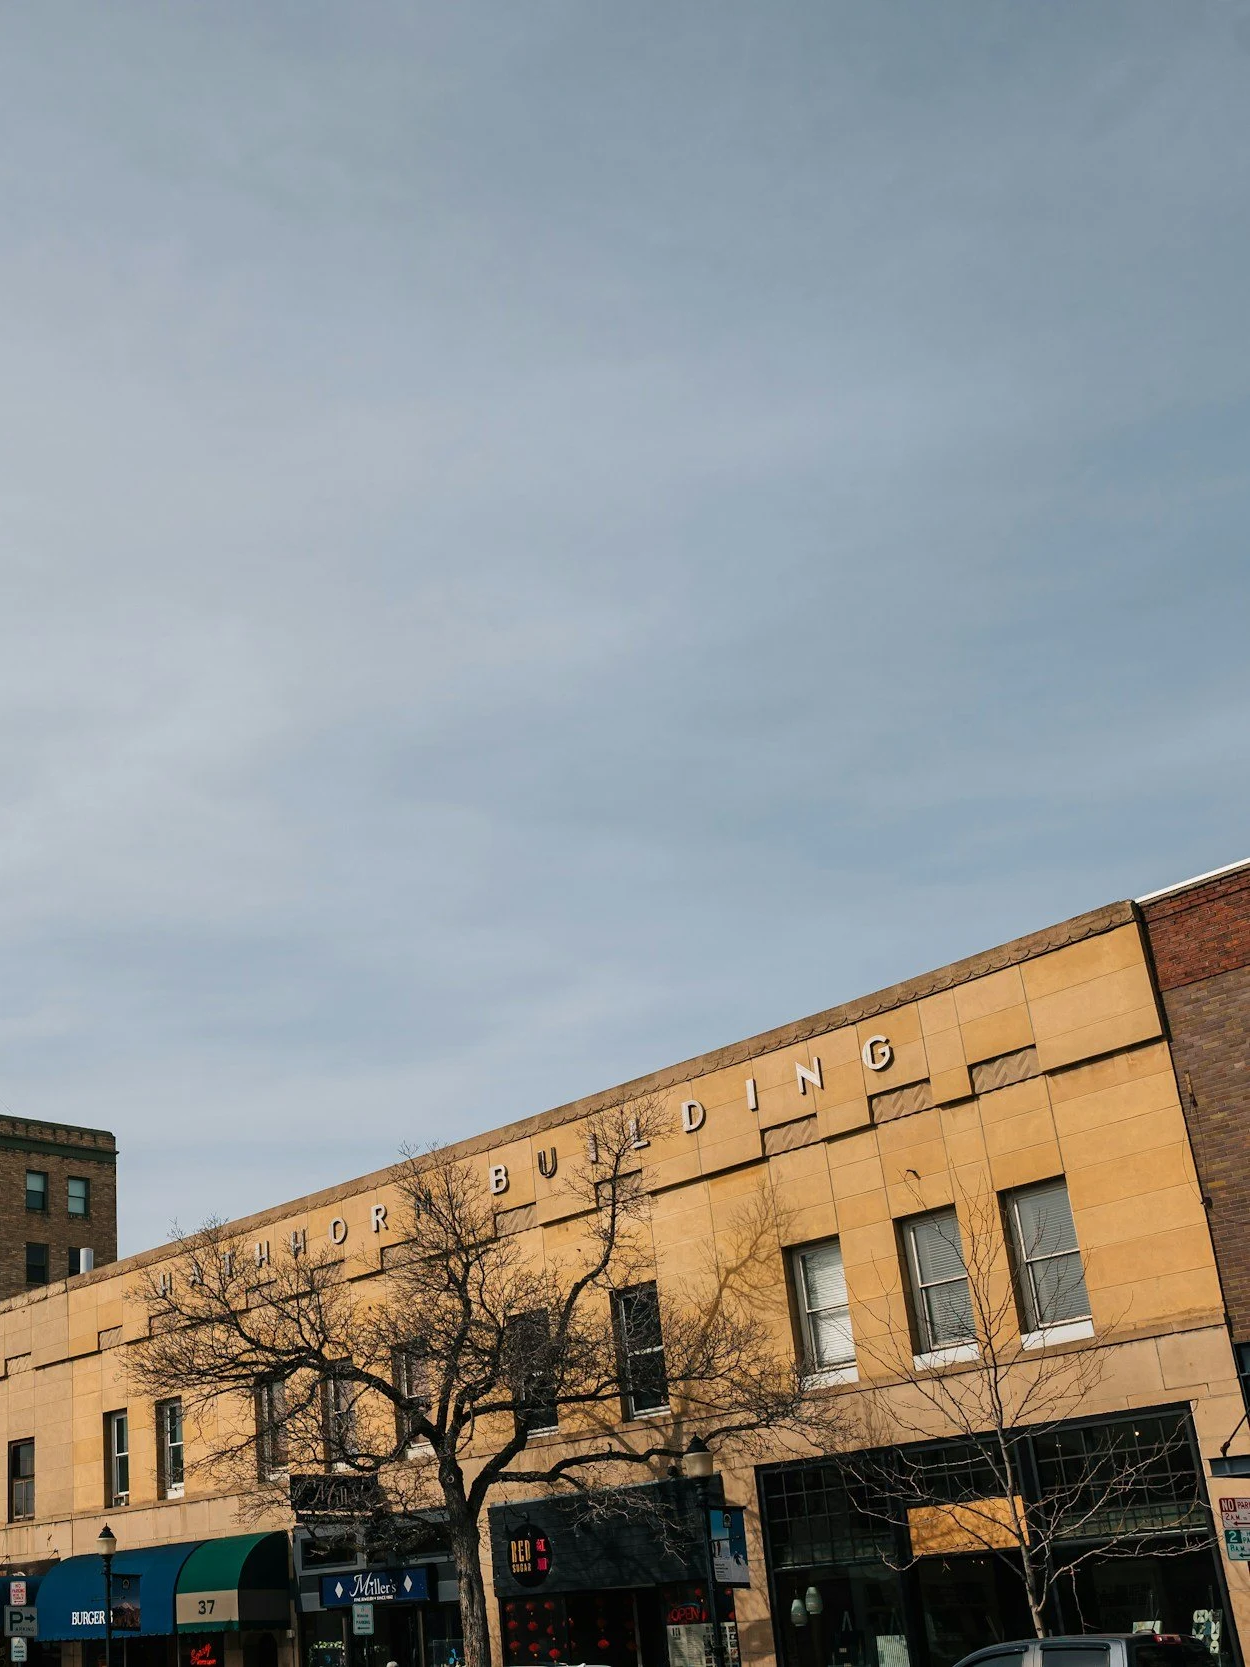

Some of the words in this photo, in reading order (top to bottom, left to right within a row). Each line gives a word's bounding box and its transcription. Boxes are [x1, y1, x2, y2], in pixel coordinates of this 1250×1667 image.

[489, 1035, 893, 1196] BUILDING
[1221, 1499, 1235, 1512] NO
[1228, 1530, 1238, 1543] 2
[511, 1540, 530, 1563] RED
[512, 1563, 532, 1573] SUGAR
[349, 1572, 397, 1597] Miller's
[198, 1600, 215, 1615] 37
[671, 1606, 699, 1621] OPEN
[71, 1610, 106, 1625] BURGER
